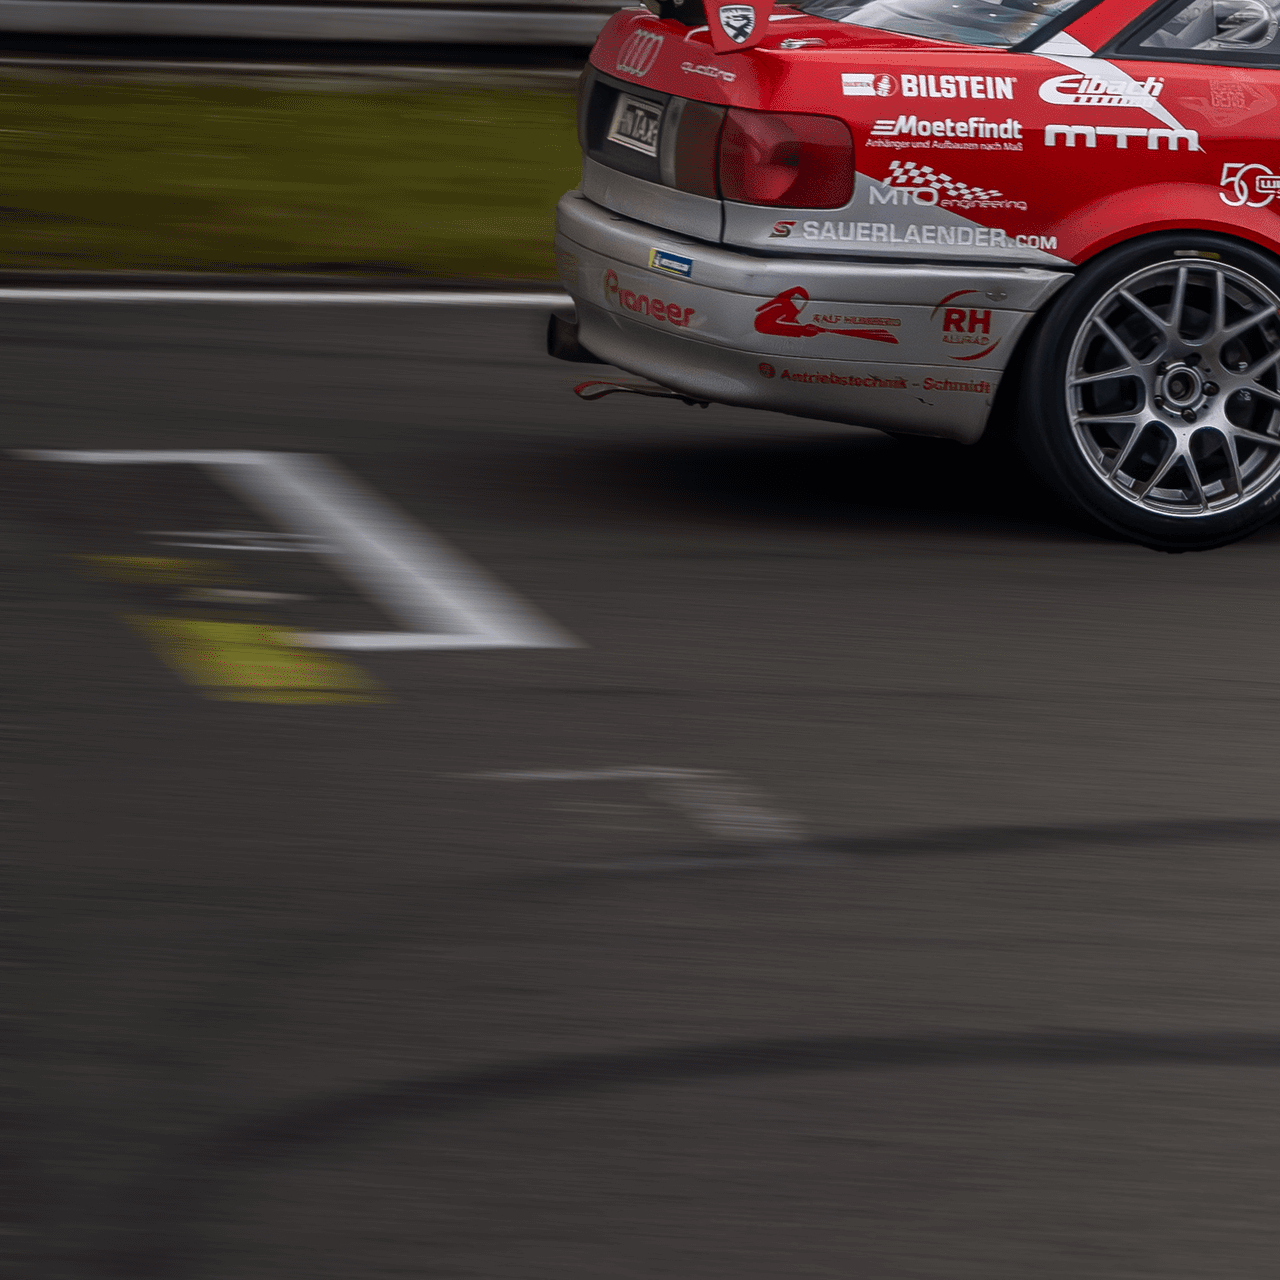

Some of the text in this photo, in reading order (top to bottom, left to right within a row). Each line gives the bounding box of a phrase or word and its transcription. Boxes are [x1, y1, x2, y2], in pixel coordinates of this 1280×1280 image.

[901, 74, 1014, 99] BILSTEIN
[1038, 74, 1162, 107] Eibach
[895, 115, 1023, 139] Moetefindt
[869, 185, 939, 207] MTO
[940, 199, 1028, 211] engineering
[802, 220, 1058, 250] SAUERLAENDER.COM
[604, 268, 696, 328] Pioneer
[942, 308, 992, 335] RH
